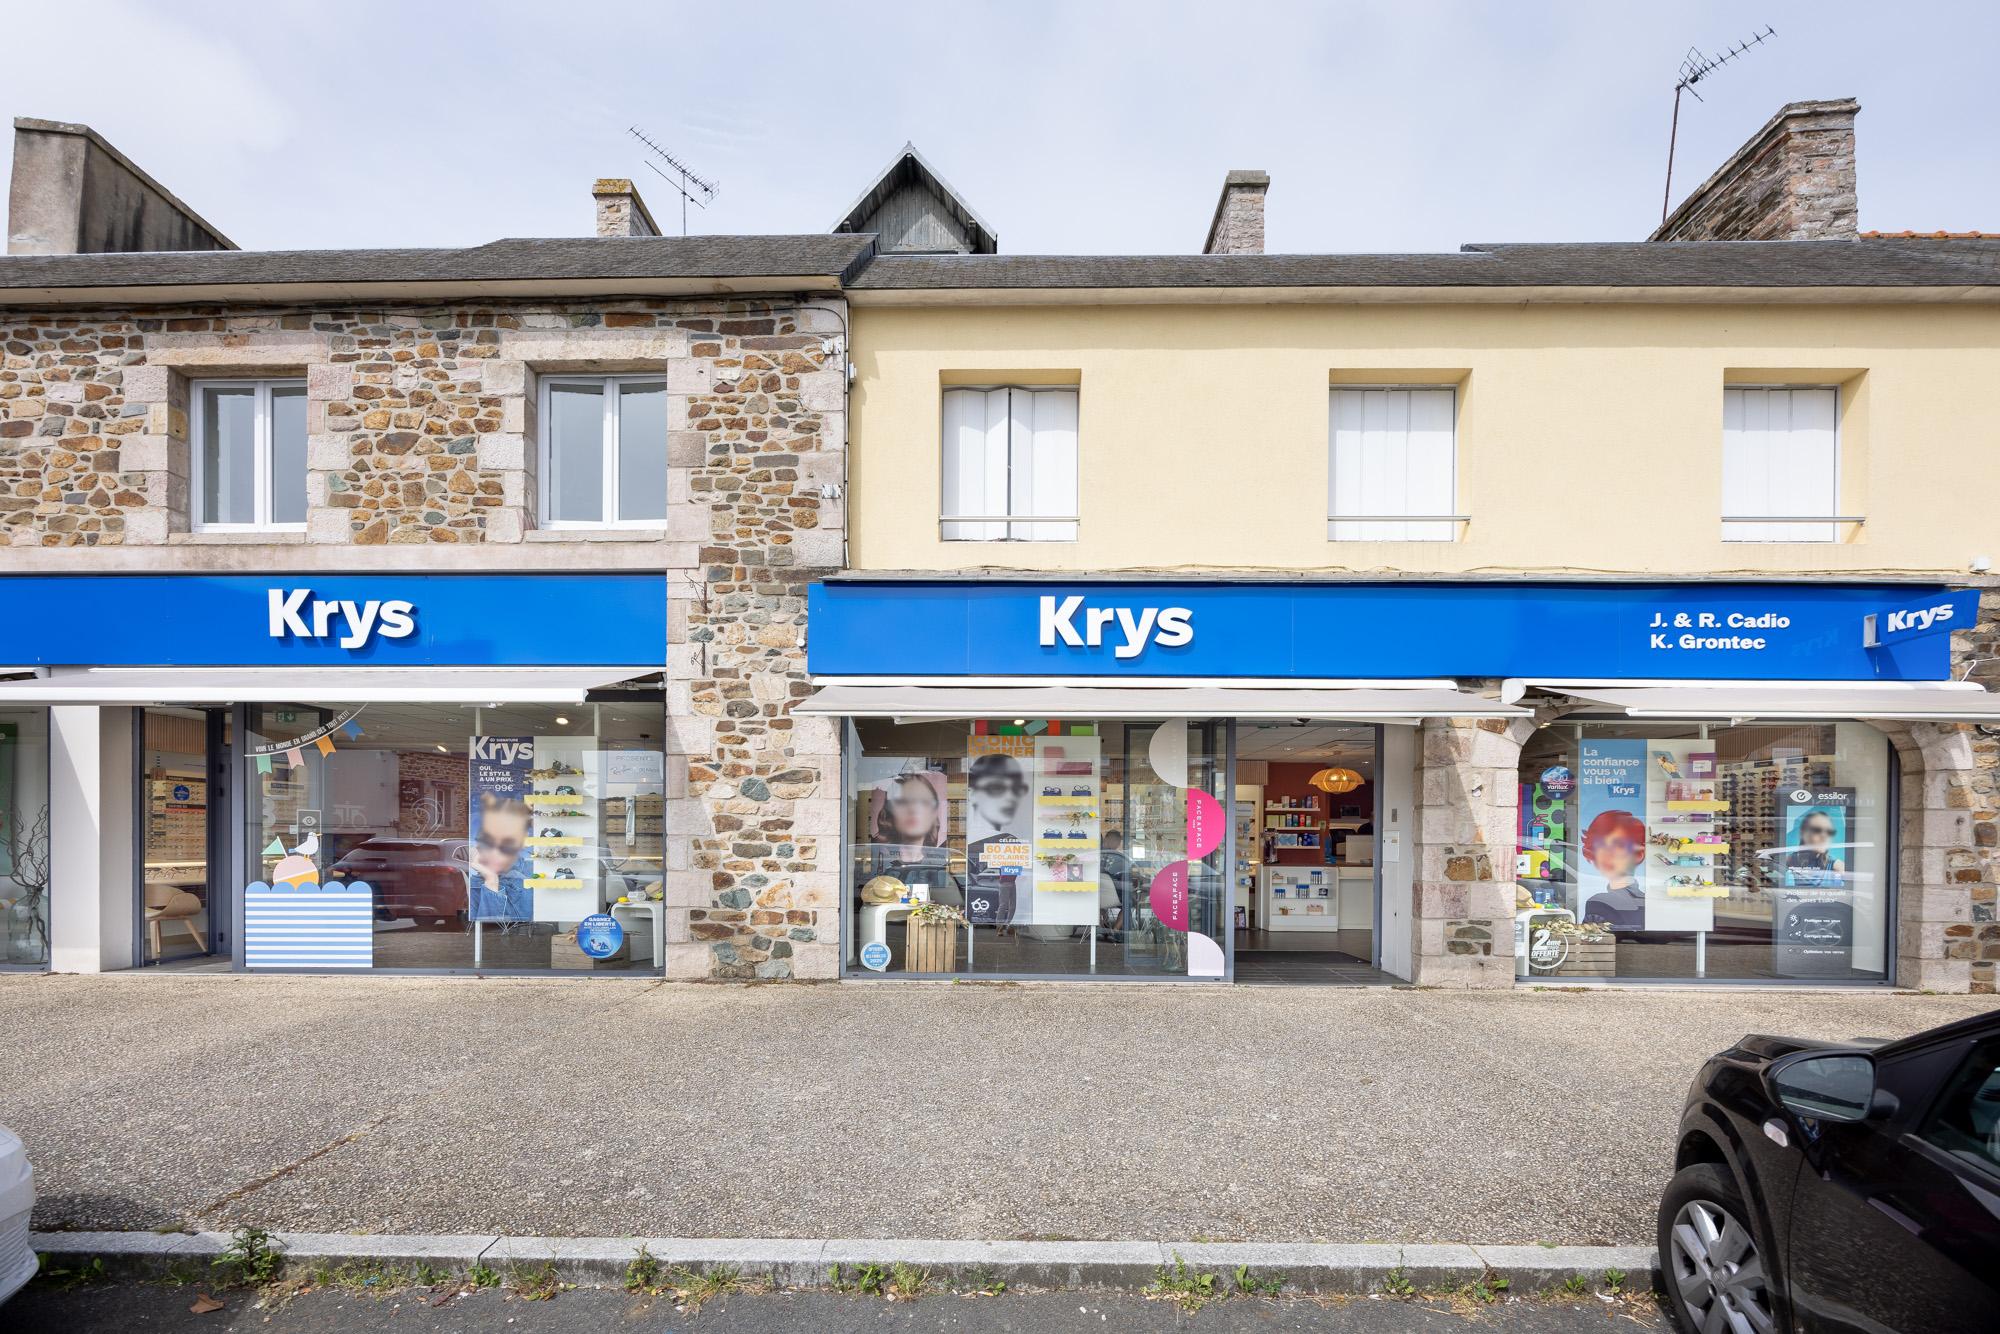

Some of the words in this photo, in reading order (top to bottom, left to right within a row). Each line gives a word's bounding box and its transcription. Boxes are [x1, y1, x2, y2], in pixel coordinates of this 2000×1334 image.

[268, 588, 416, 649] Krys
[1649, 612, 1668, 628] J.
[1673, 612, 1693, 628] &
[1698, 612, 1722, 628] R.
[1727, 612, 1791, 629] Cadio
[1887, 603, 1955, 633] Krys
[1039, 595, 1195, 659] Krys
[1650, 633, 1674, 649] K.
[1678, 633, 1766, 650] Grontec
[469, 735, 534, 766] Krys
[1583, 747, 1599, 757] La
[1583, 757, 1640, 767] confiance
[1583, 768, 1611, 776] vous
[1612, 768, 1627, 776] va
[1583, 776, 1593, 785] si
[1595, 775, 1620, 785] bien
[494, 784, 514, 792] 99€
[1612, 785, 1635, 796] Krys
[1817, 791, 1849, 801] essilor
[986, 844, 1001, 854] 60
[1004, 844, 1030, 854] ANS
[1004, 866, 1019, 874] Krys
